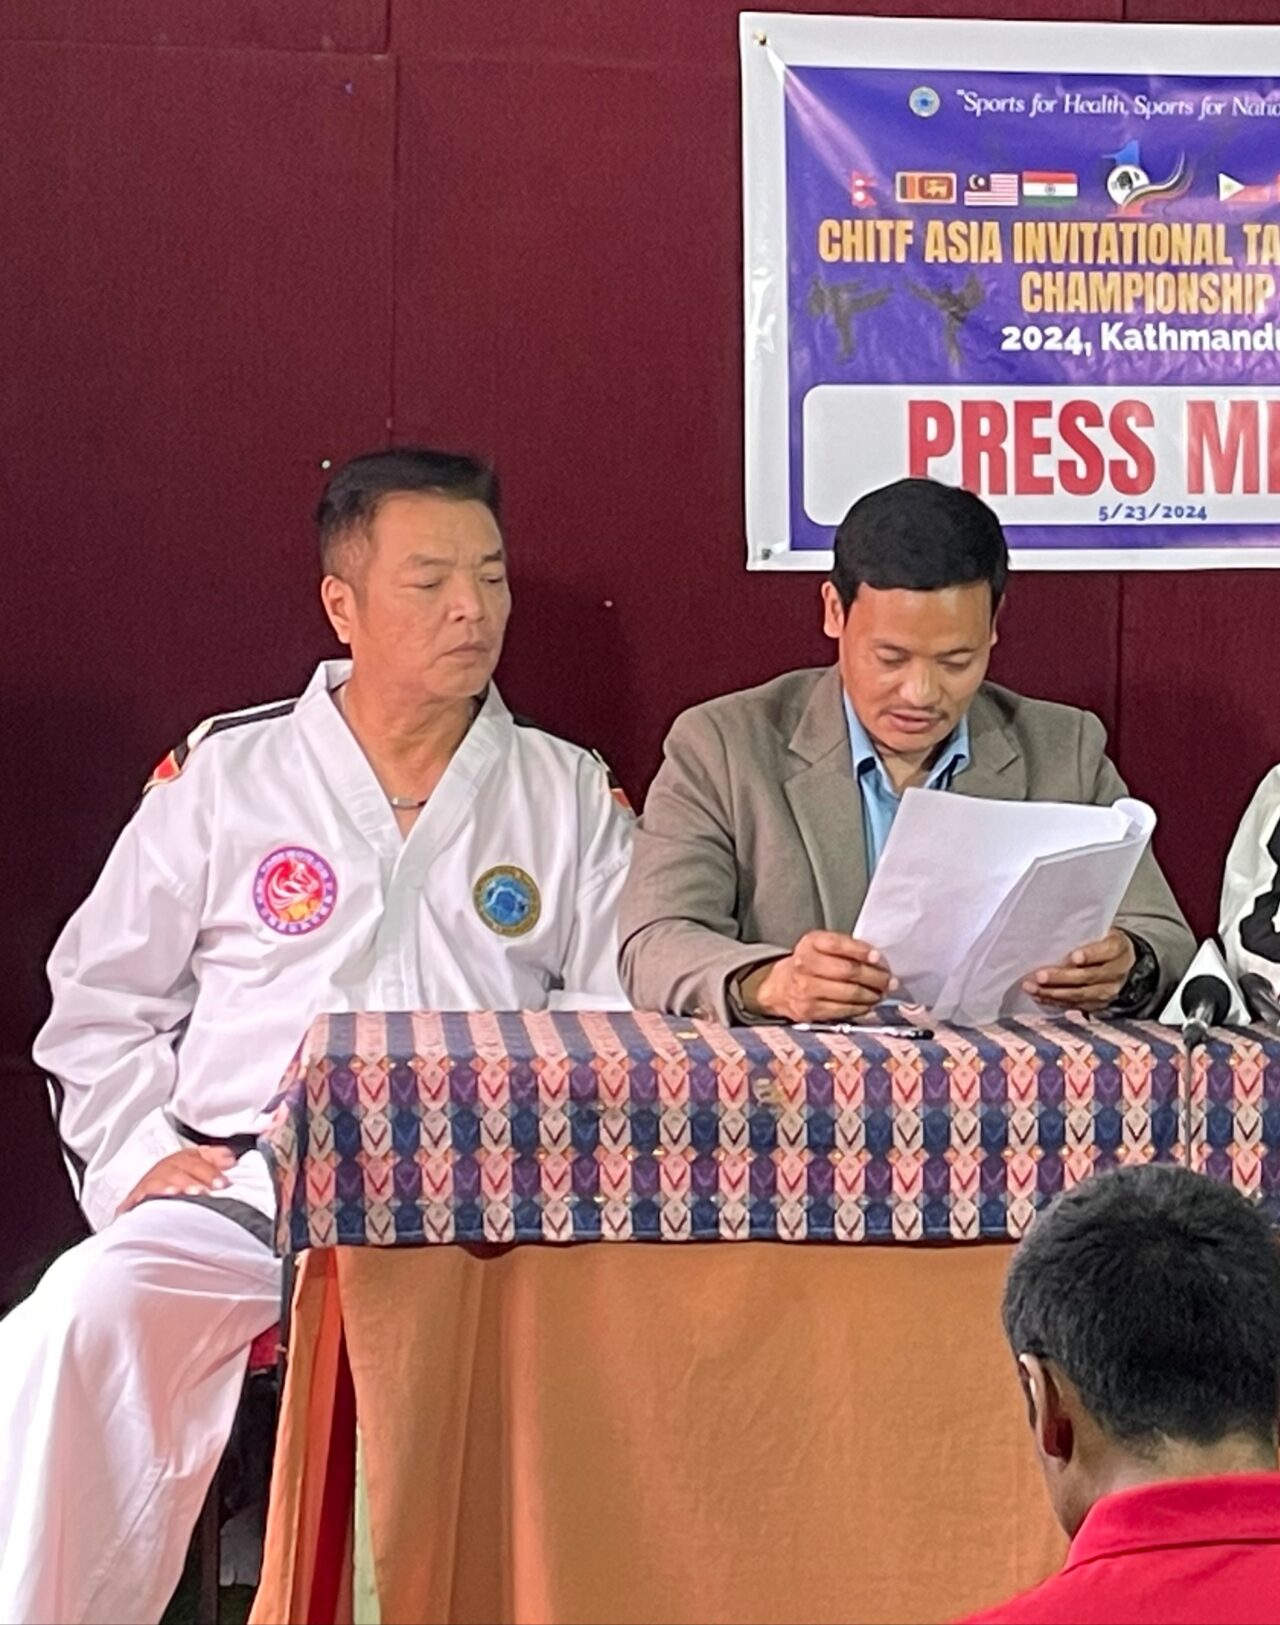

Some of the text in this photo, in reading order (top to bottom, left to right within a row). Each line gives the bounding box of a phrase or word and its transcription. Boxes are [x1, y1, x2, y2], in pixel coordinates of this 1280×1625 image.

[957, 88, 1025, 117] "Sports
[1029, 93, 1057, 118] for
[1064, 93, 1129, 116] Health,
[1133, 94, 1193, 120] Sports
[1198, 95, 1227, 120] for
[818, 218, 914, 263] CHITF
[924, 219, 1003, 264] ASIA
[1013, 221, 1233, 265] INVITATIONAL
[1021, 270, 1276, 315] CHAMPIONSHIP
[1000, 325, 1092, 357] 2024,
[908, 399, 1156, 496] PRESS
[1098, 503, 1207, 521] 5/23/2024
